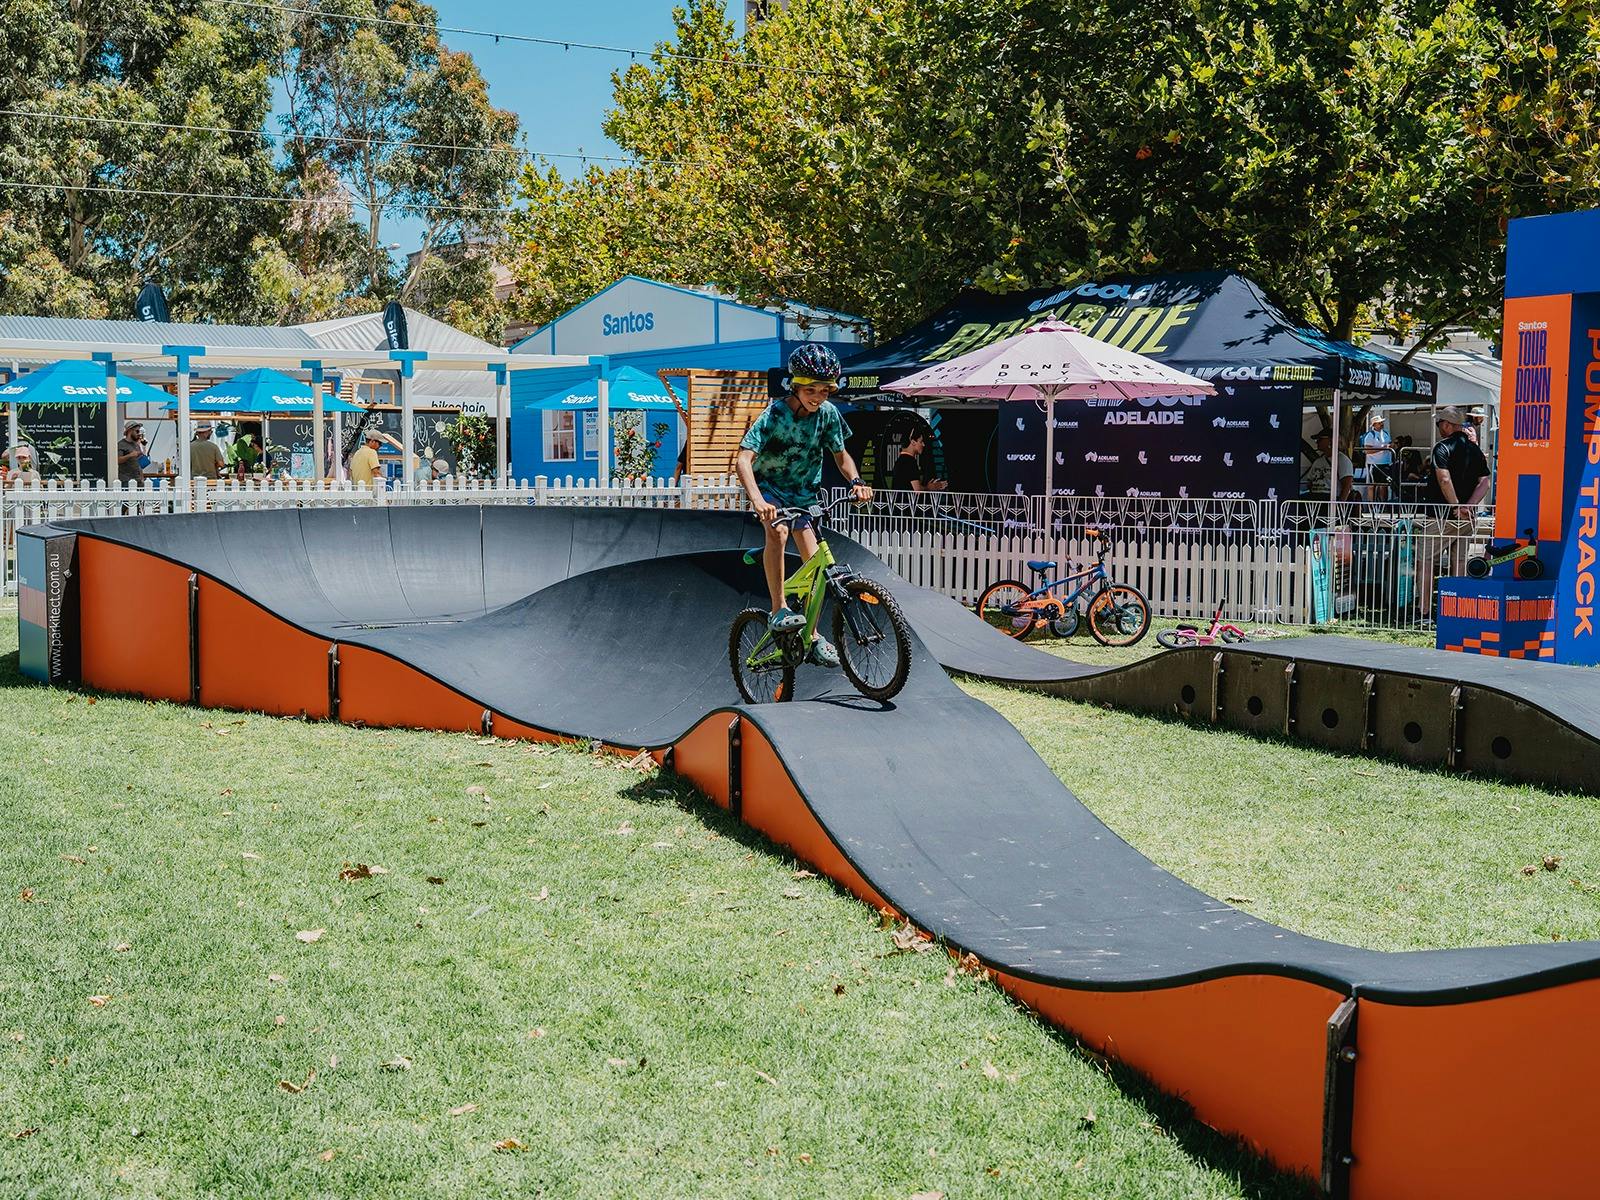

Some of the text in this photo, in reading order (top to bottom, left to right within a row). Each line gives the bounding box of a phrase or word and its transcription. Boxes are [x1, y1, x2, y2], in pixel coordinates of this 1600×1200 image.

[603, 311, 654, 336] Santos
[1518, 321, 1547, 330] Santos
[1518, 329, 1548, 367] TOUR
[62, 385, 132, 395] Sants
[1515, 367, 1551, 403] DOWN
[200, 396, 242, 404] Santos
[272, 395, 314, 404] Santo
[1103, 411, 1184, 425] ADELAIDE
[1513, 404, 1551, 440] UNDER
[1574, 477, 1599, 639] TRACK
[50, 553, 63, 678] www.parkitect.com.au
